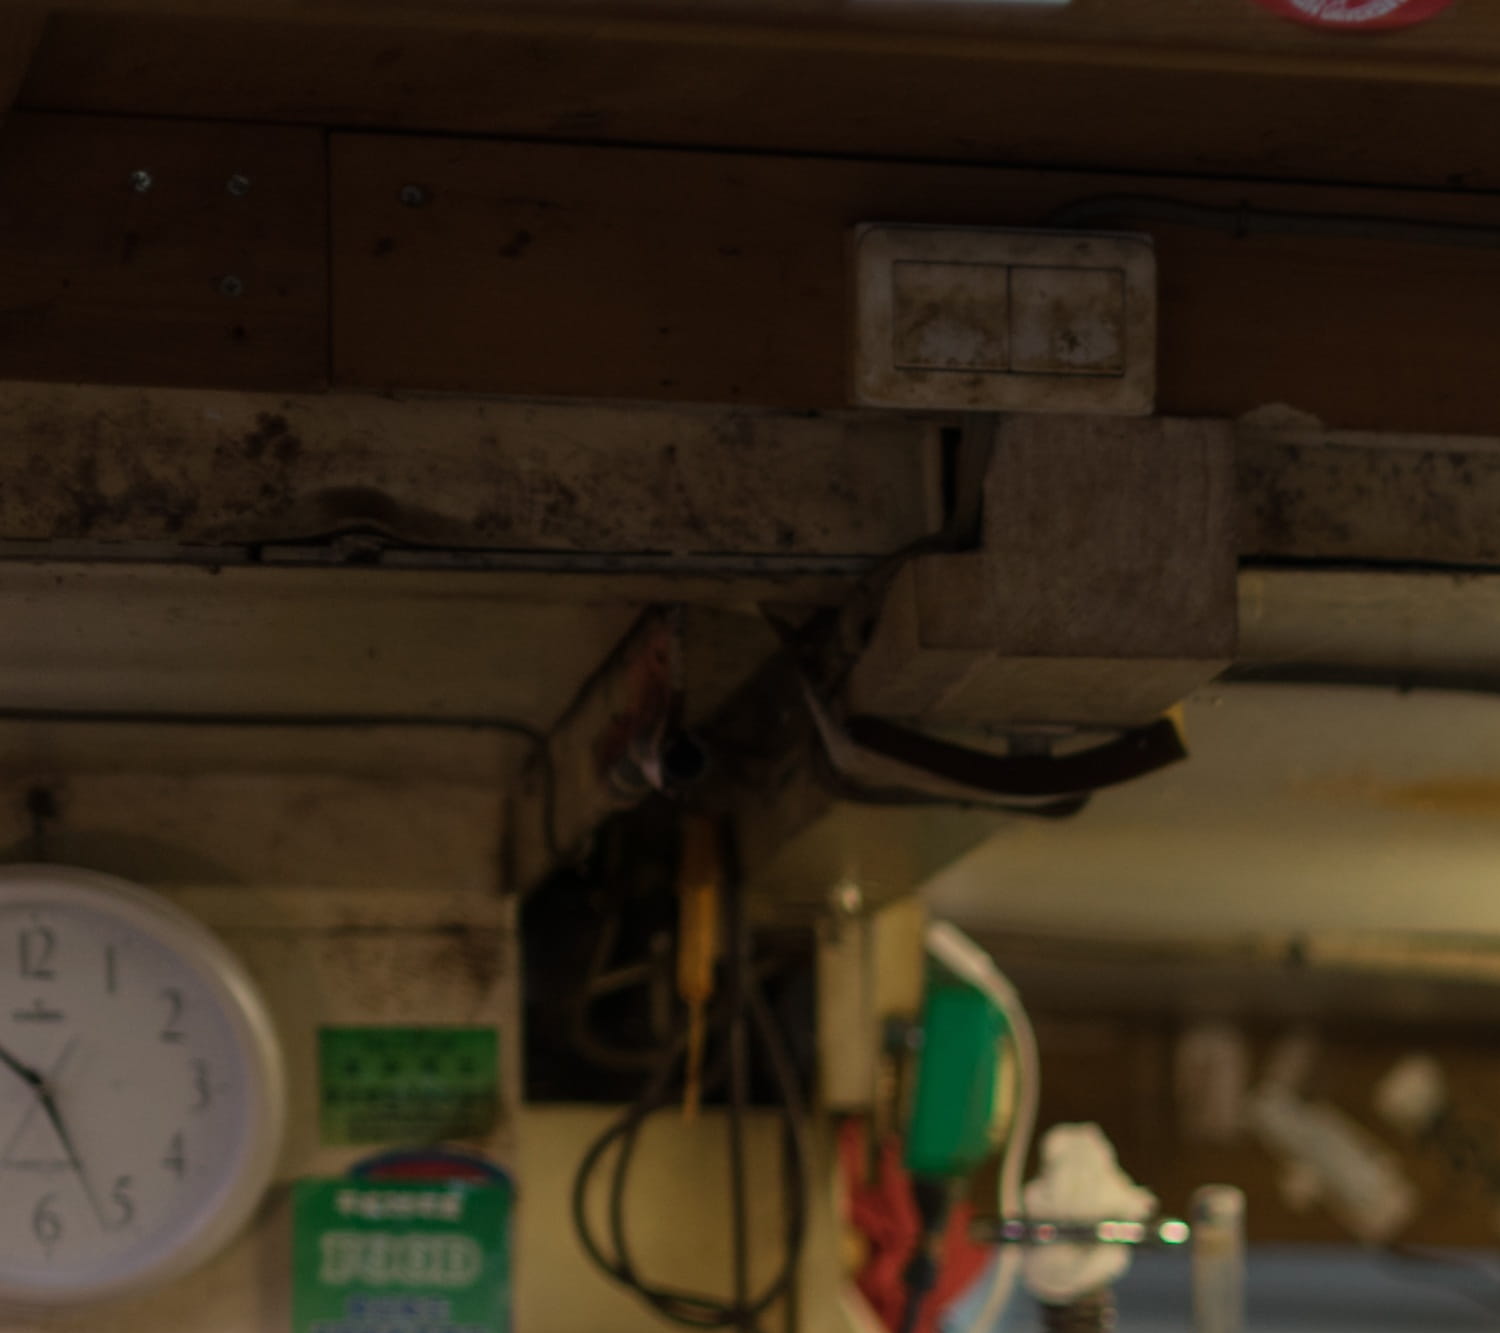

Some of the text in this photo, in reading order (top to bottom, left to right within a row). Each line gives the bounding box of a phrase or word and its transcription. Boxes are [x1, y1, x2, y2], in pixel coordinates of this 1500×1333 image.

[18, 926, 56, 981] 12
[105, 944, 119, 993] 1
[160, 987, 185, 1042] 2
[189, 1057, 212, 1112] 3
[160, 1131, 186, 1178] 4
[33, 1192, 62, 1243] 6
[108, 1175, 135, 1227] 5
